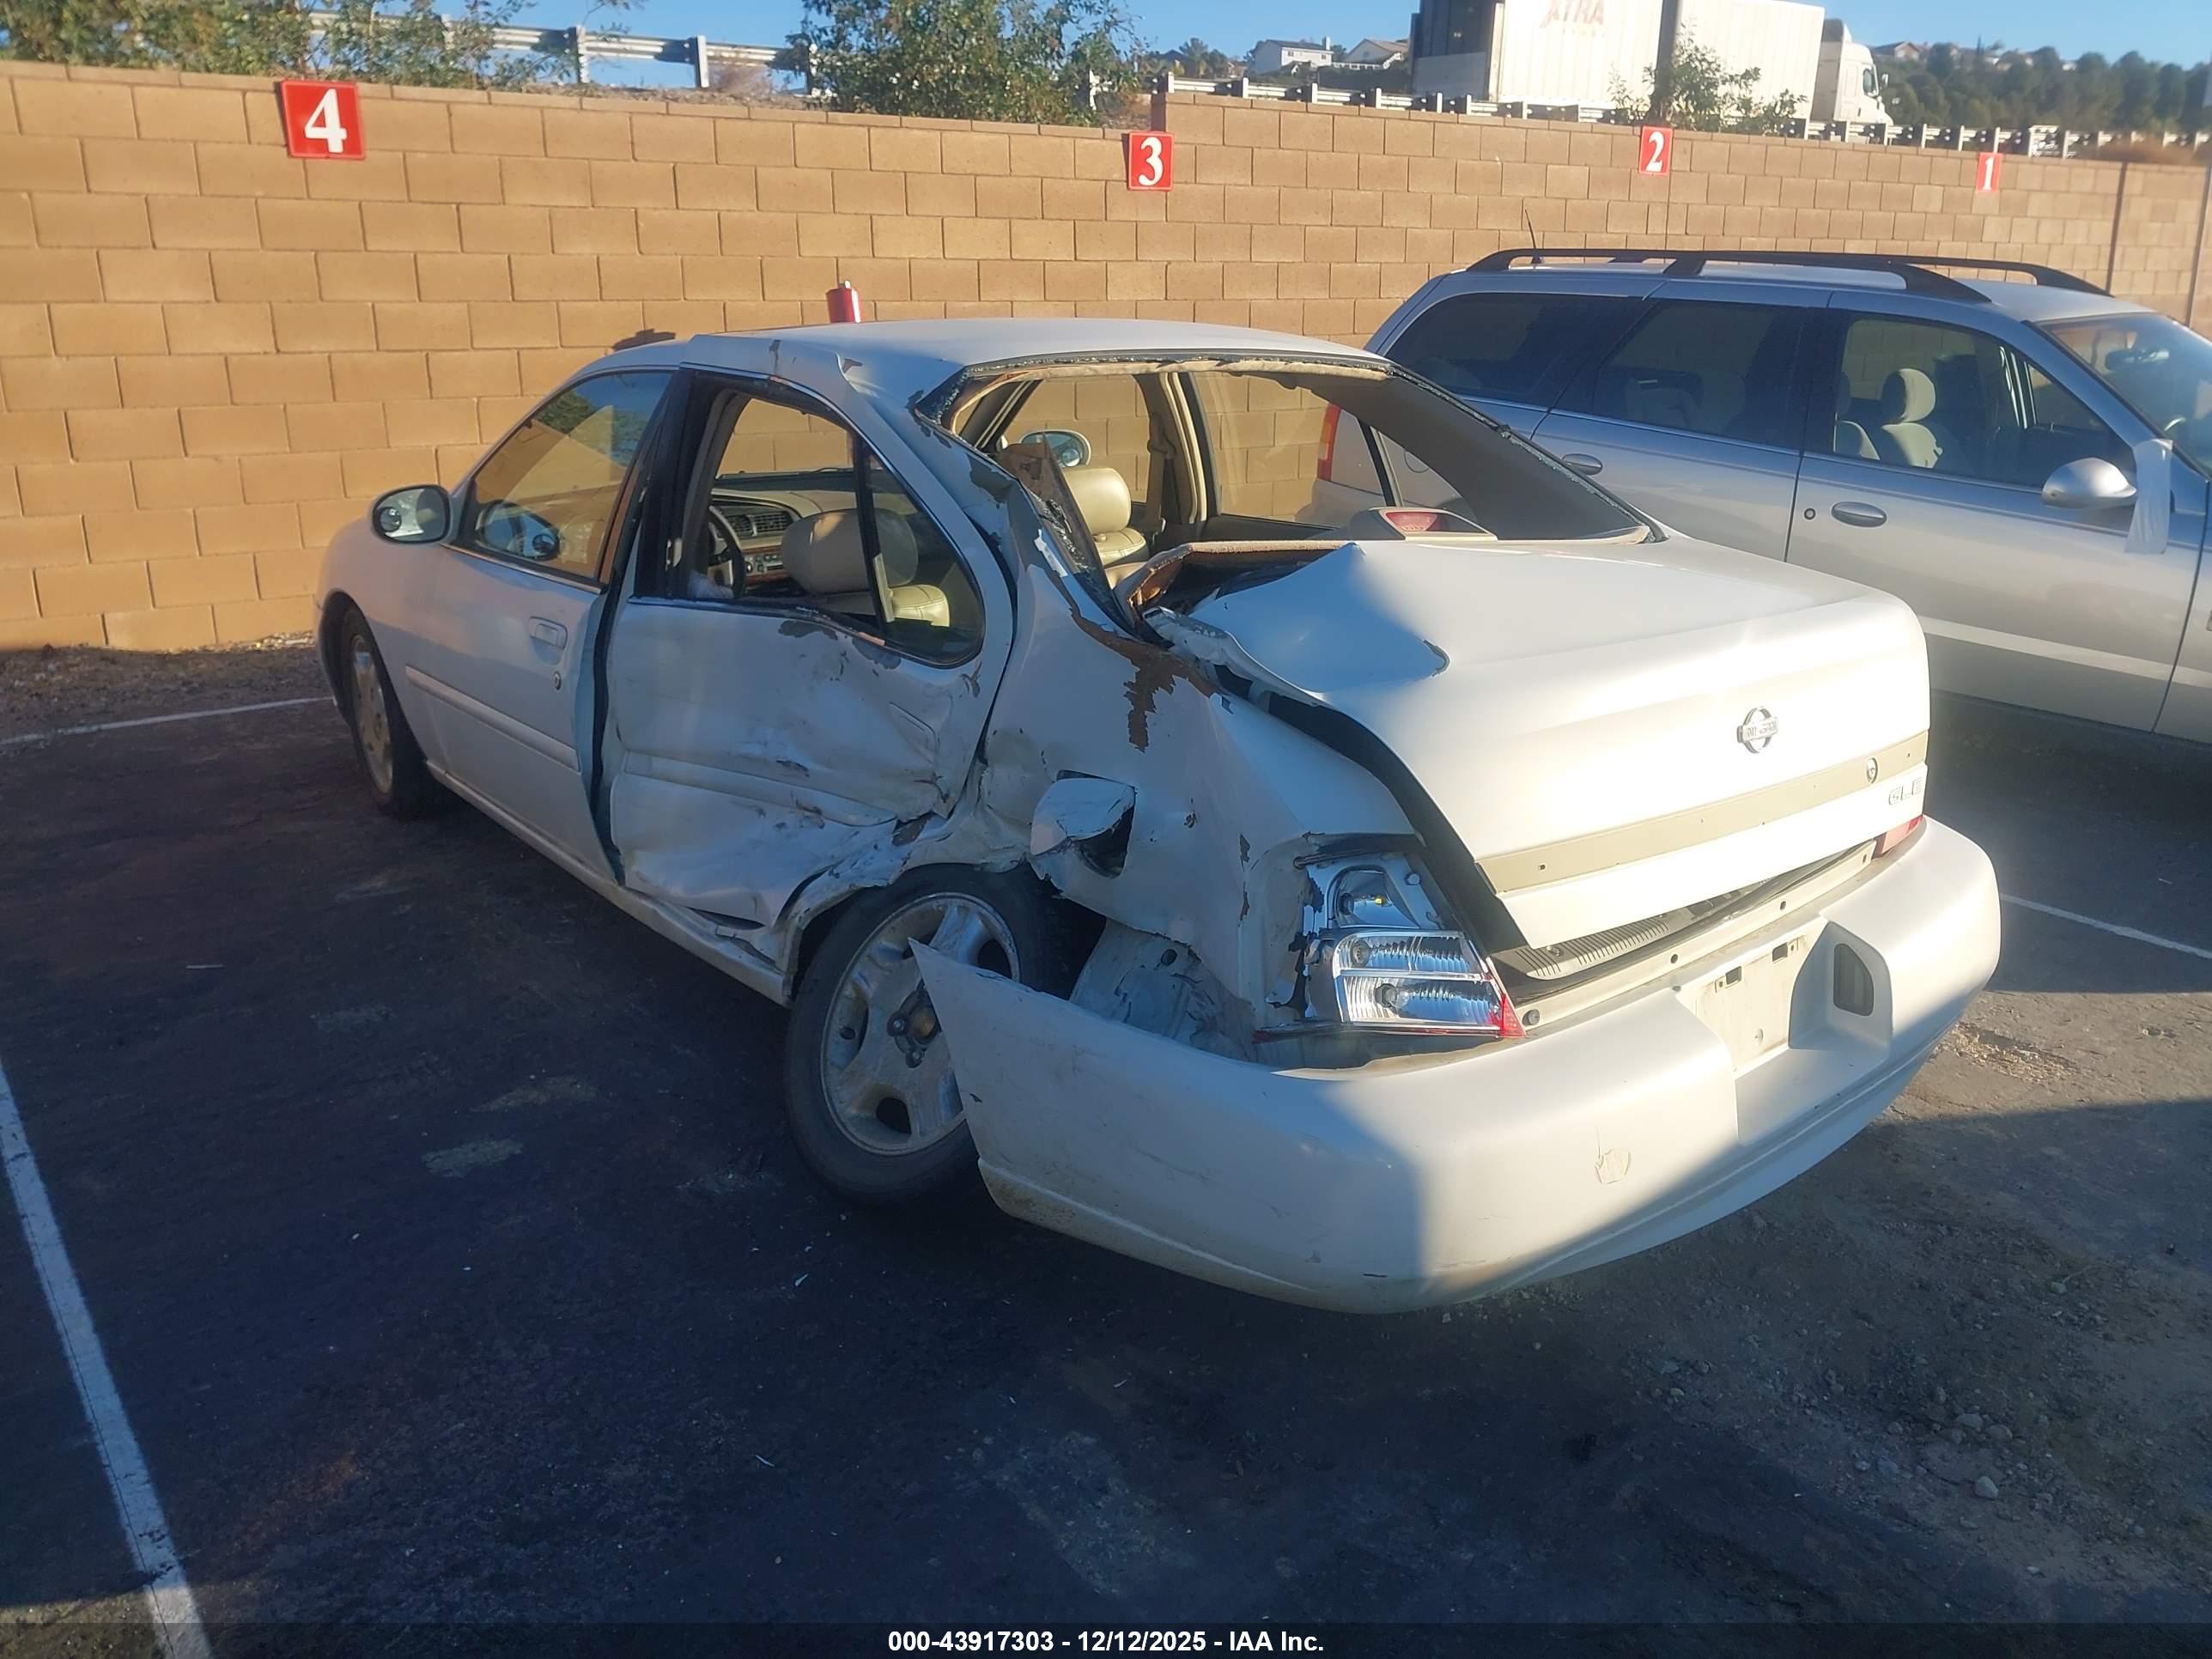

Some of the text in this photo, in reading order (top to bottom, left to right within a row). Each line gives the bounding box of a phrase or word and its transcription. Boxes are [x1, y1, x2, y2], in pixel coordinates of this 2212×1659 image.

[304, 88, 348, 154] 4
[1138, 137, 1164, 186] 3
[1645, 131, 1664, 173] 2
[1982, 156, 1994, 191] 1
